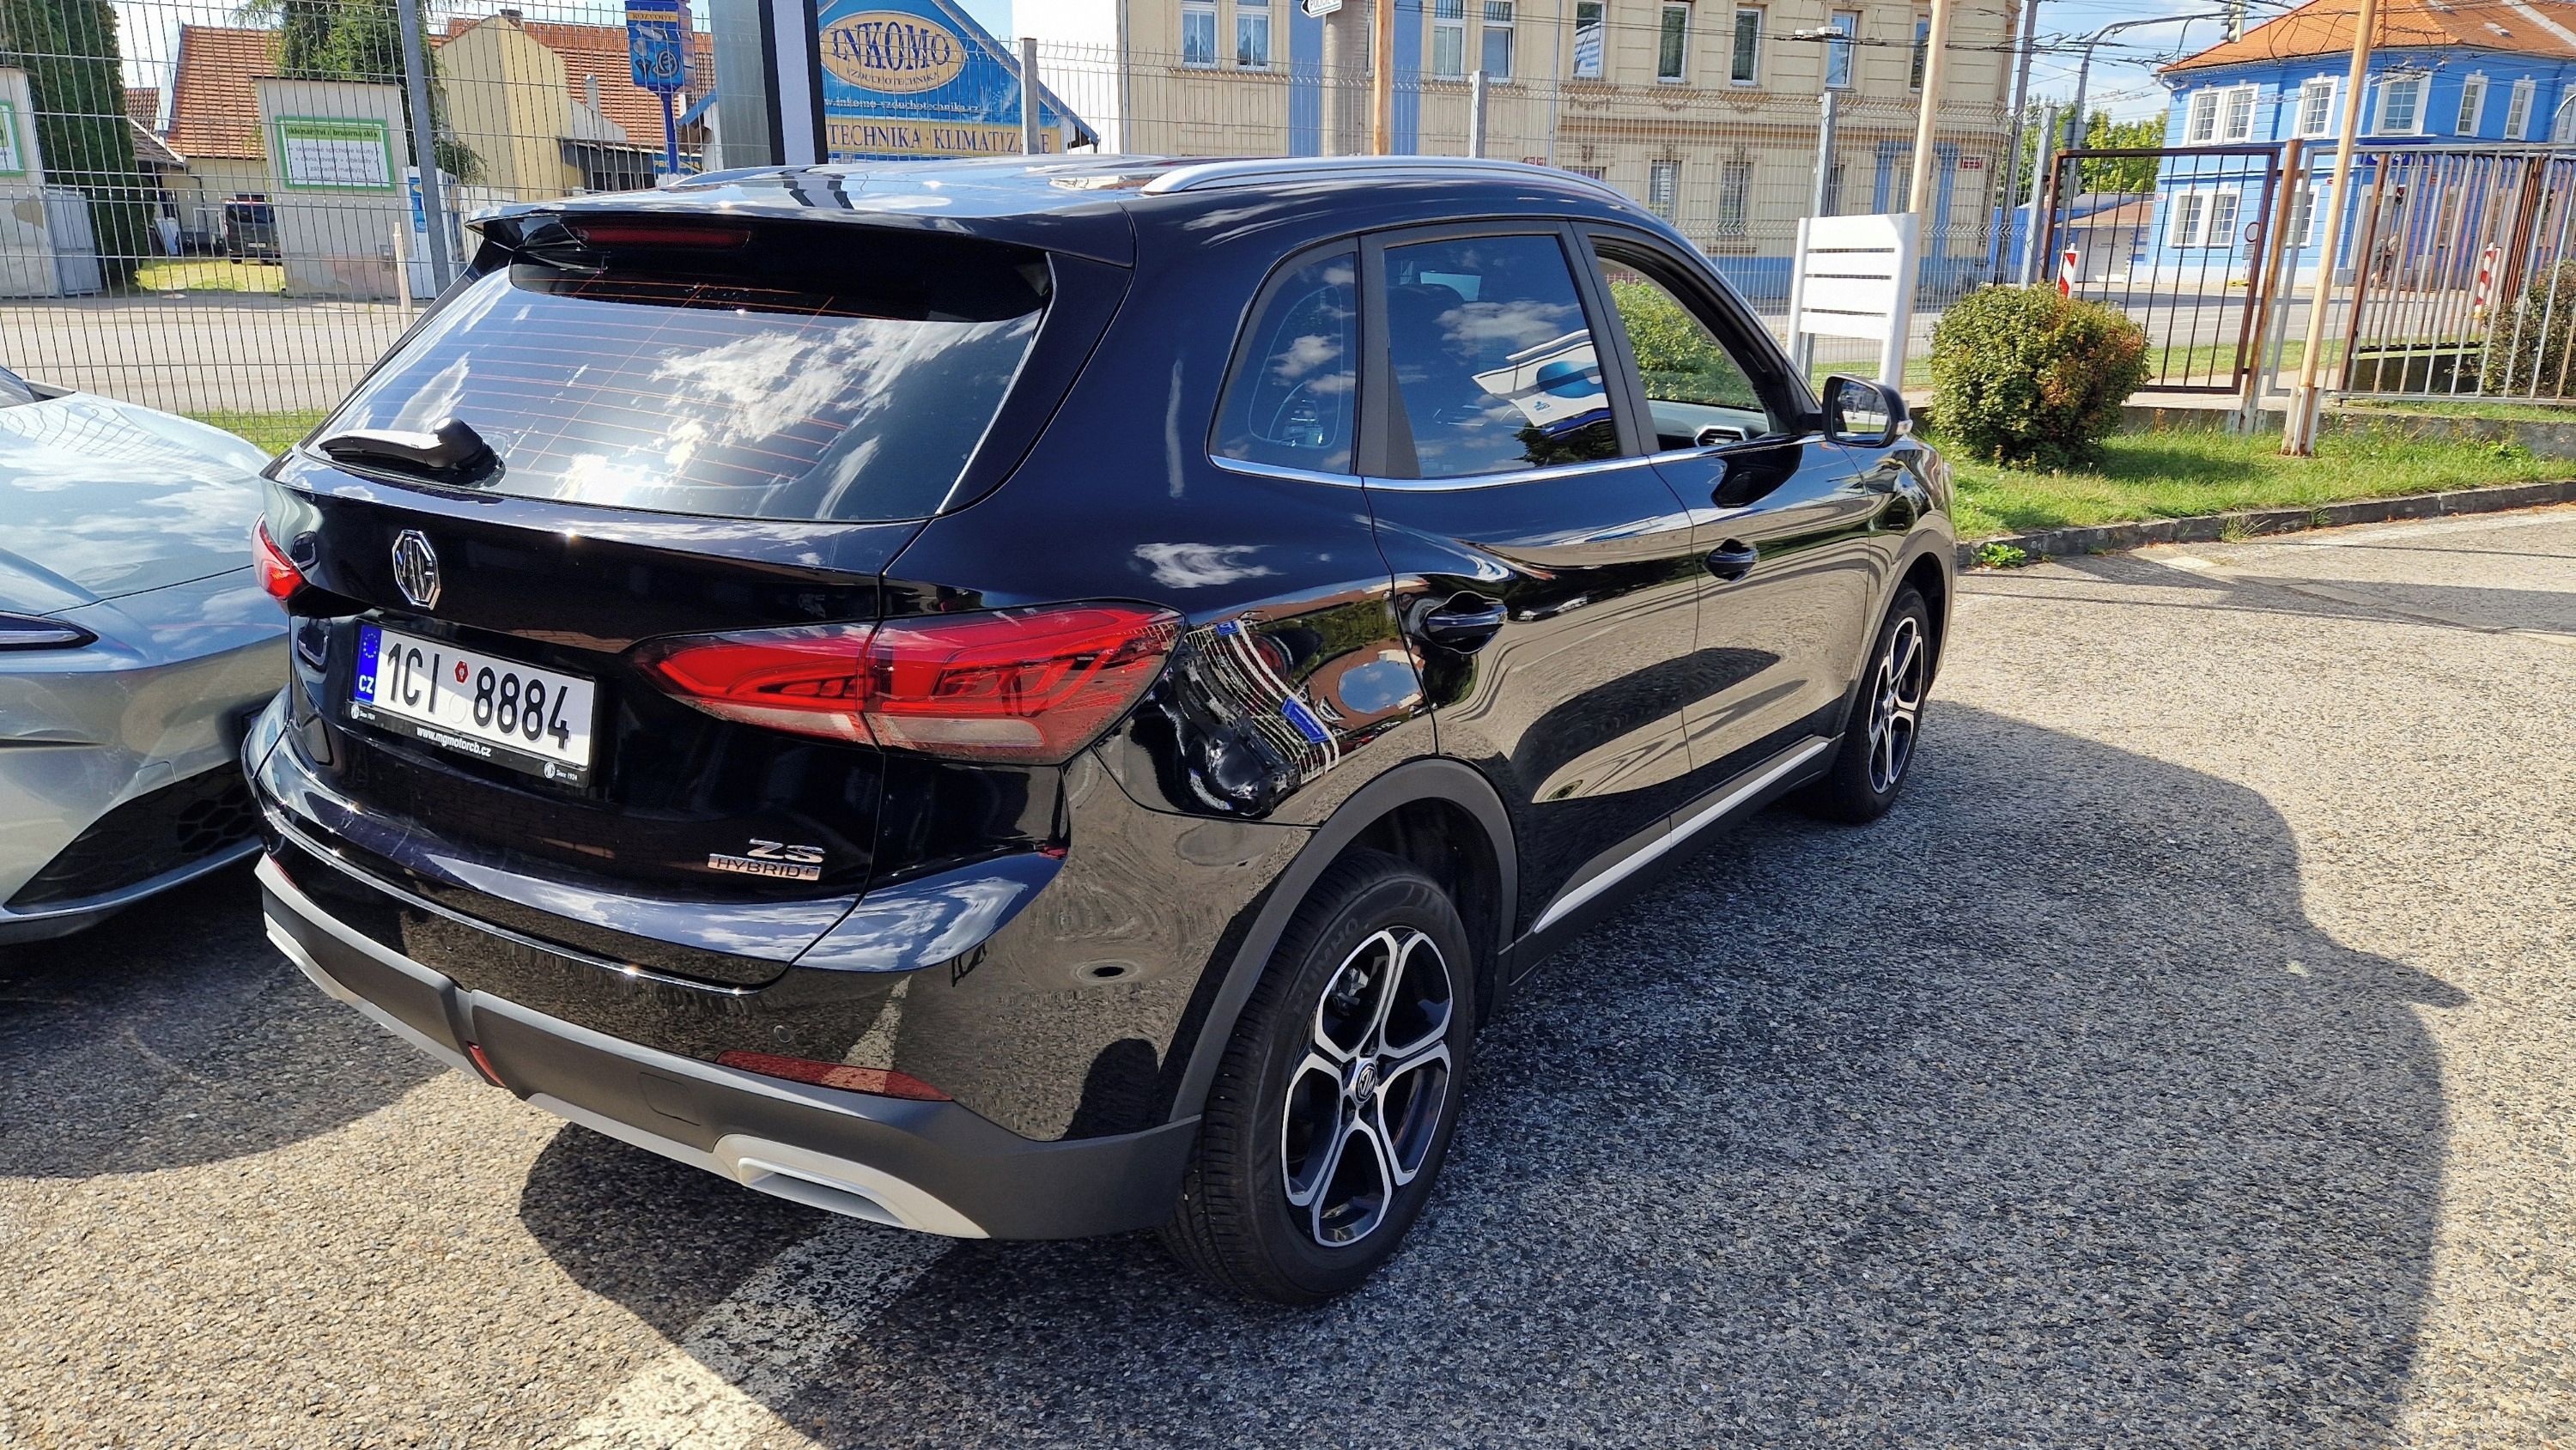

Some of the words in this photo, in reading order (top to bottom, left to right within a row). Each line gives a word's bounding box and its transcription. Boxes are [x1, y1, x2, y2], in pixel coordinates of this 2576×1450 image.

[830, 21, 951, 71] INKOMO
[934, 127, 1050, 154] KLIMATIZE
[359, 674, 374, 695] CZ
[387, 642, 440, 714] 1CI
[473, 666, 570, 749] 8884
[416, 726, 492, 757] www.mgmotorcb.cz
[747, 838, 825, 864] ZS
